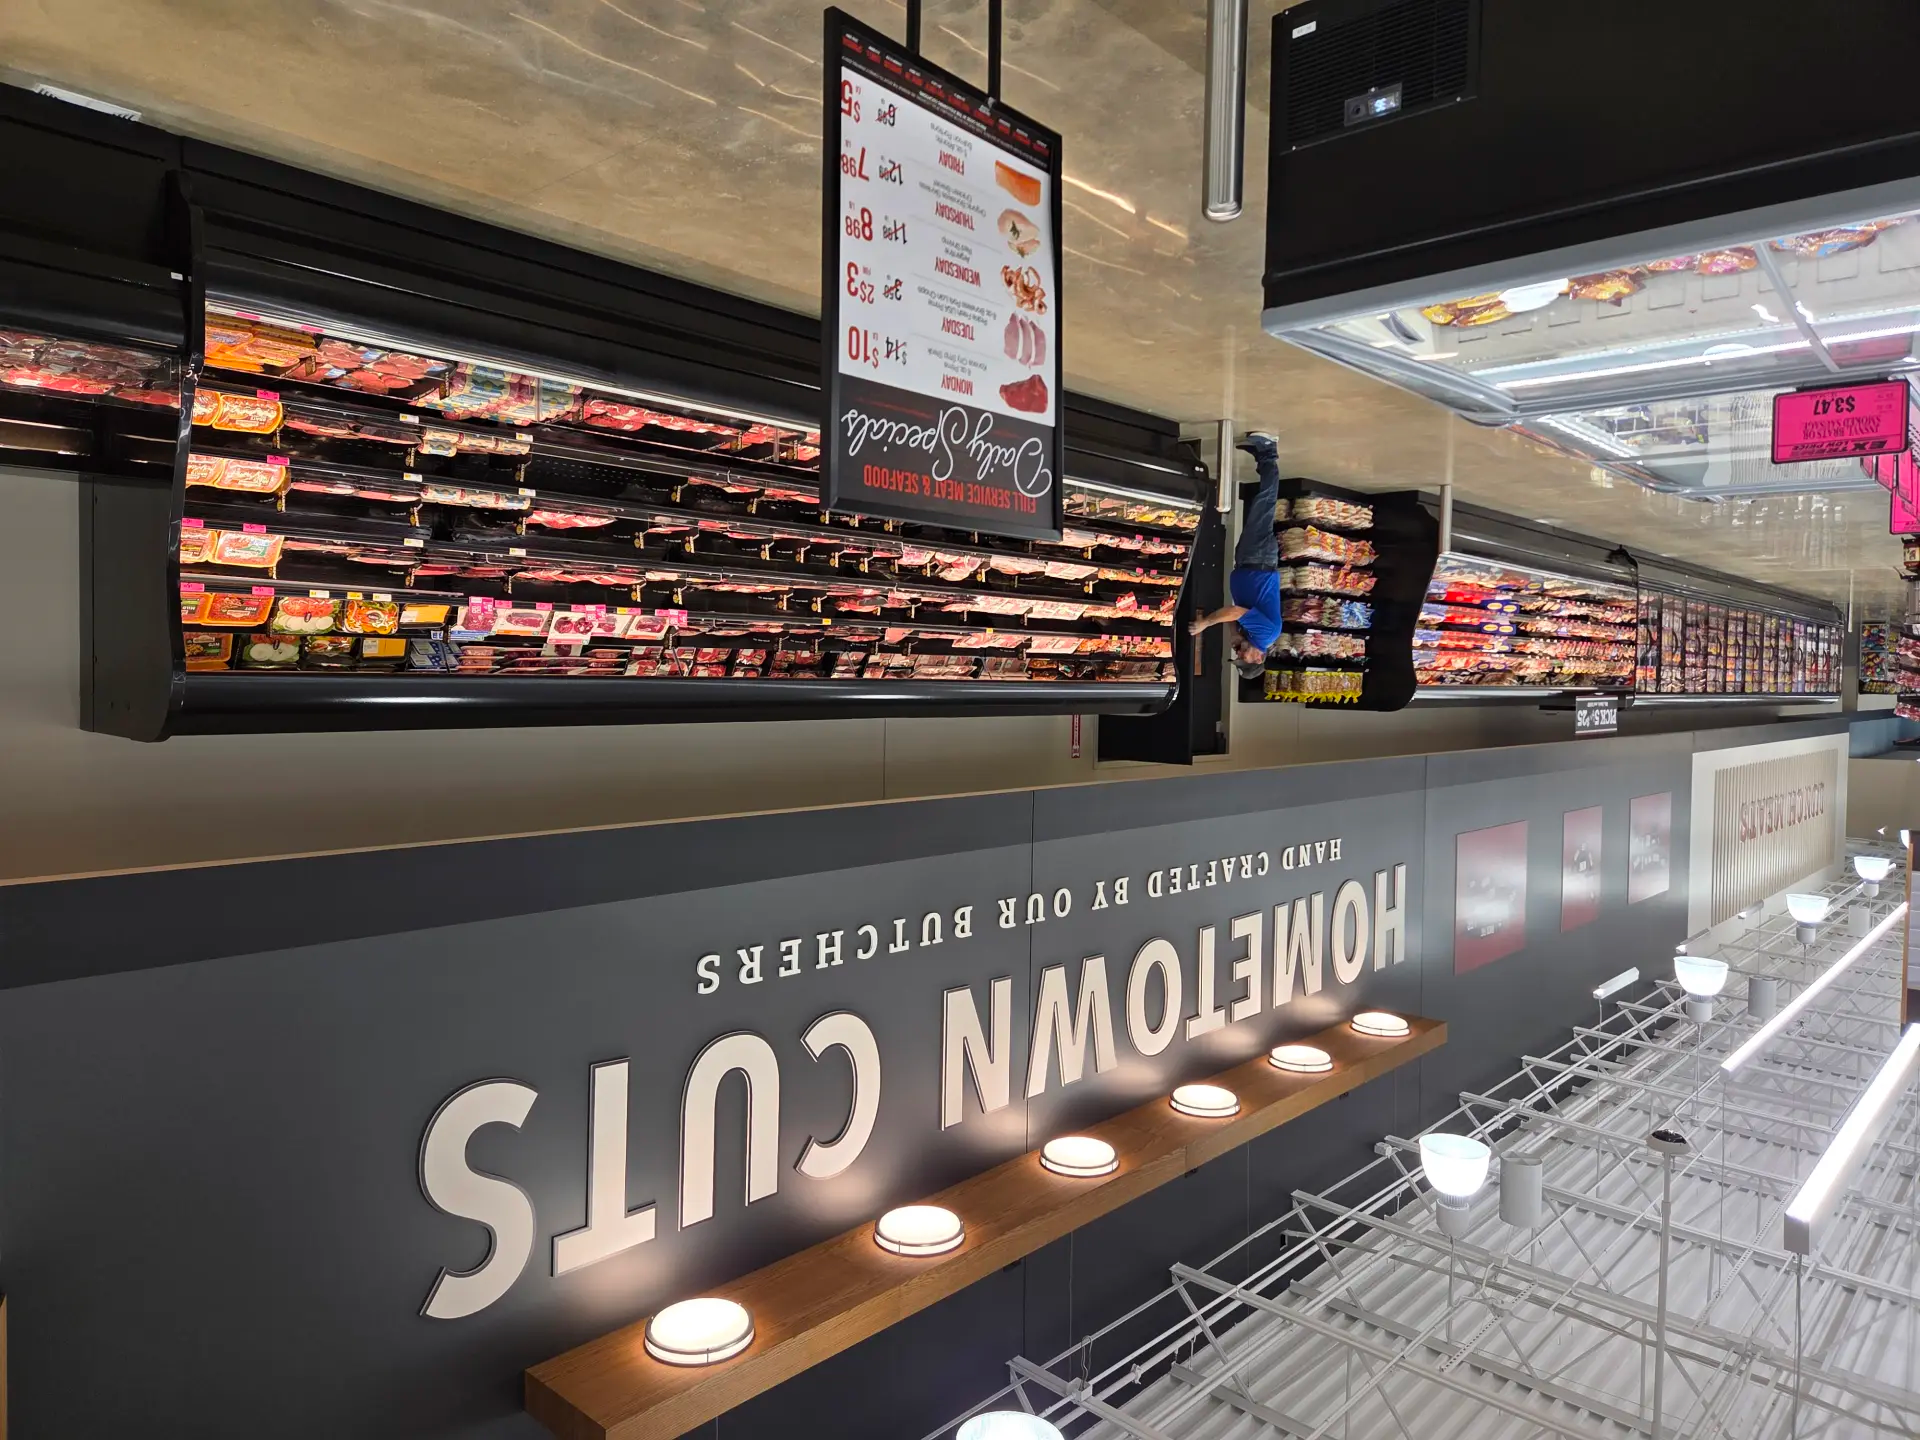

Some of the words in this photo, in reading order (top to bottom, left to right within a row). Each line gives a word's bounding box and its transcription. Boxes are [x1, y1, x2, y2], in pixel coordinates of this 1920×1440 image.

[938, 150, 965, 176] FRIDAY
[935, 201, 975, 232] THURSDAY
[934, 256, 982, 288] WEDNESDAY
[944, 305, 957, 316] USA
[941, 316, 975, 342] TUESDAY
[848, 326, 879, 369] $10
[957, 354, 968, 366] City
[940, 374, 974, 396] MONDAY
[1813, 395, 1856, 415] $3.47
[1803, 419, 1842, 432] SAUSAGE
[1816, 426, 1844, 439] BRATS
[1842, 414, 1880, 428] SMOKED
[841, 406, 968, 482] Specials
[1792, 442, 1824, 450] PRICE
[1802, 430, 1816, 440] OR
[1826, 440, 1849, 448] LOW
[966, 412, 1052, 498] Daily
[863, 464, 918, 494] SEAFOOD
[922, 474, 930, 496] &
[933, 478, 964, 502] MEAT
[967, 483, 1010, 508] SERVICE
[1011, 491, 1036, 514] FULL
[1577, 709, 1590, 727] $25
[1600, 709, 1617, 725] PICK
[1788, 782, 1825, 827] LUNCH
[1739, 795, 1784, 843] MEATS
[1280, 838, 1343, 872] HAND
[1145, 851, 1271, 899] CRAFTED
[1091, 875, 1130, 912] BY
[994, 887, 1073, 930] OUR
[693, 907, 973, 996] BUTCHERS
[938, 863, 1408, 1131] HOMETOWN
[417, 1009, 881, 1318] CUTS
